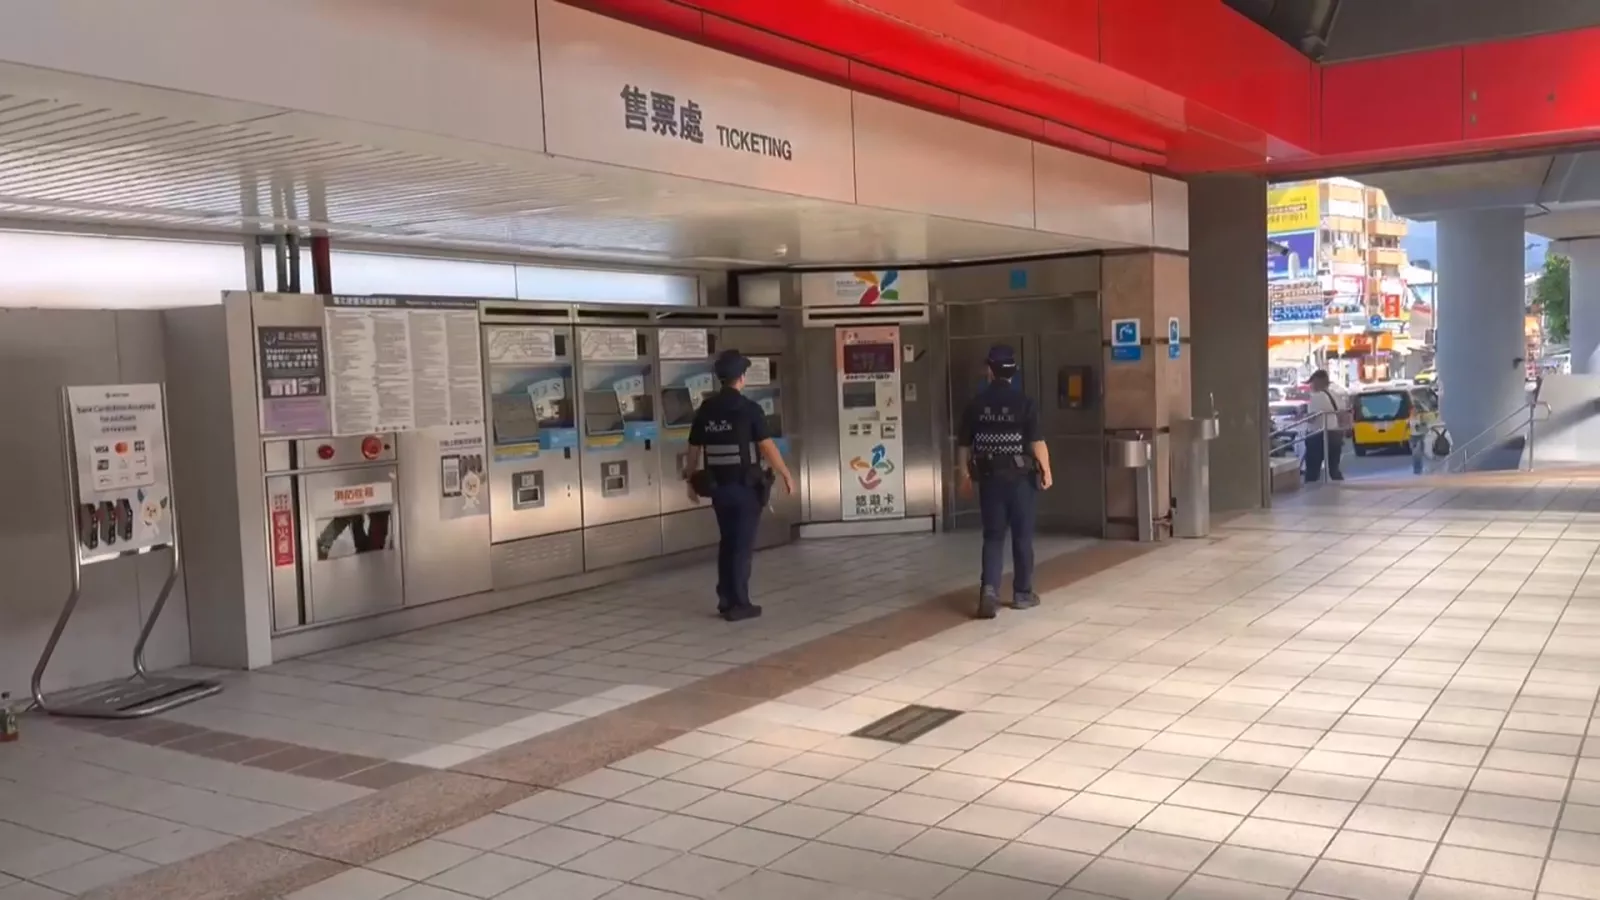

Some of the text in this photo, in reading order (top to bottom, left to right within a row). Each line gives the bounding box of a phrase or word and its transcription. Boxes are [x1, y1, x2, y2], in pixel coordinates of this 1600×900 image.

[620, 84, 792, 161] 售票處 TICKETING
[705, 423, 732, 432] POLICE
[94, 445, 109, 453] VISA
[856, 492, 894, 506] 悠遊卡
